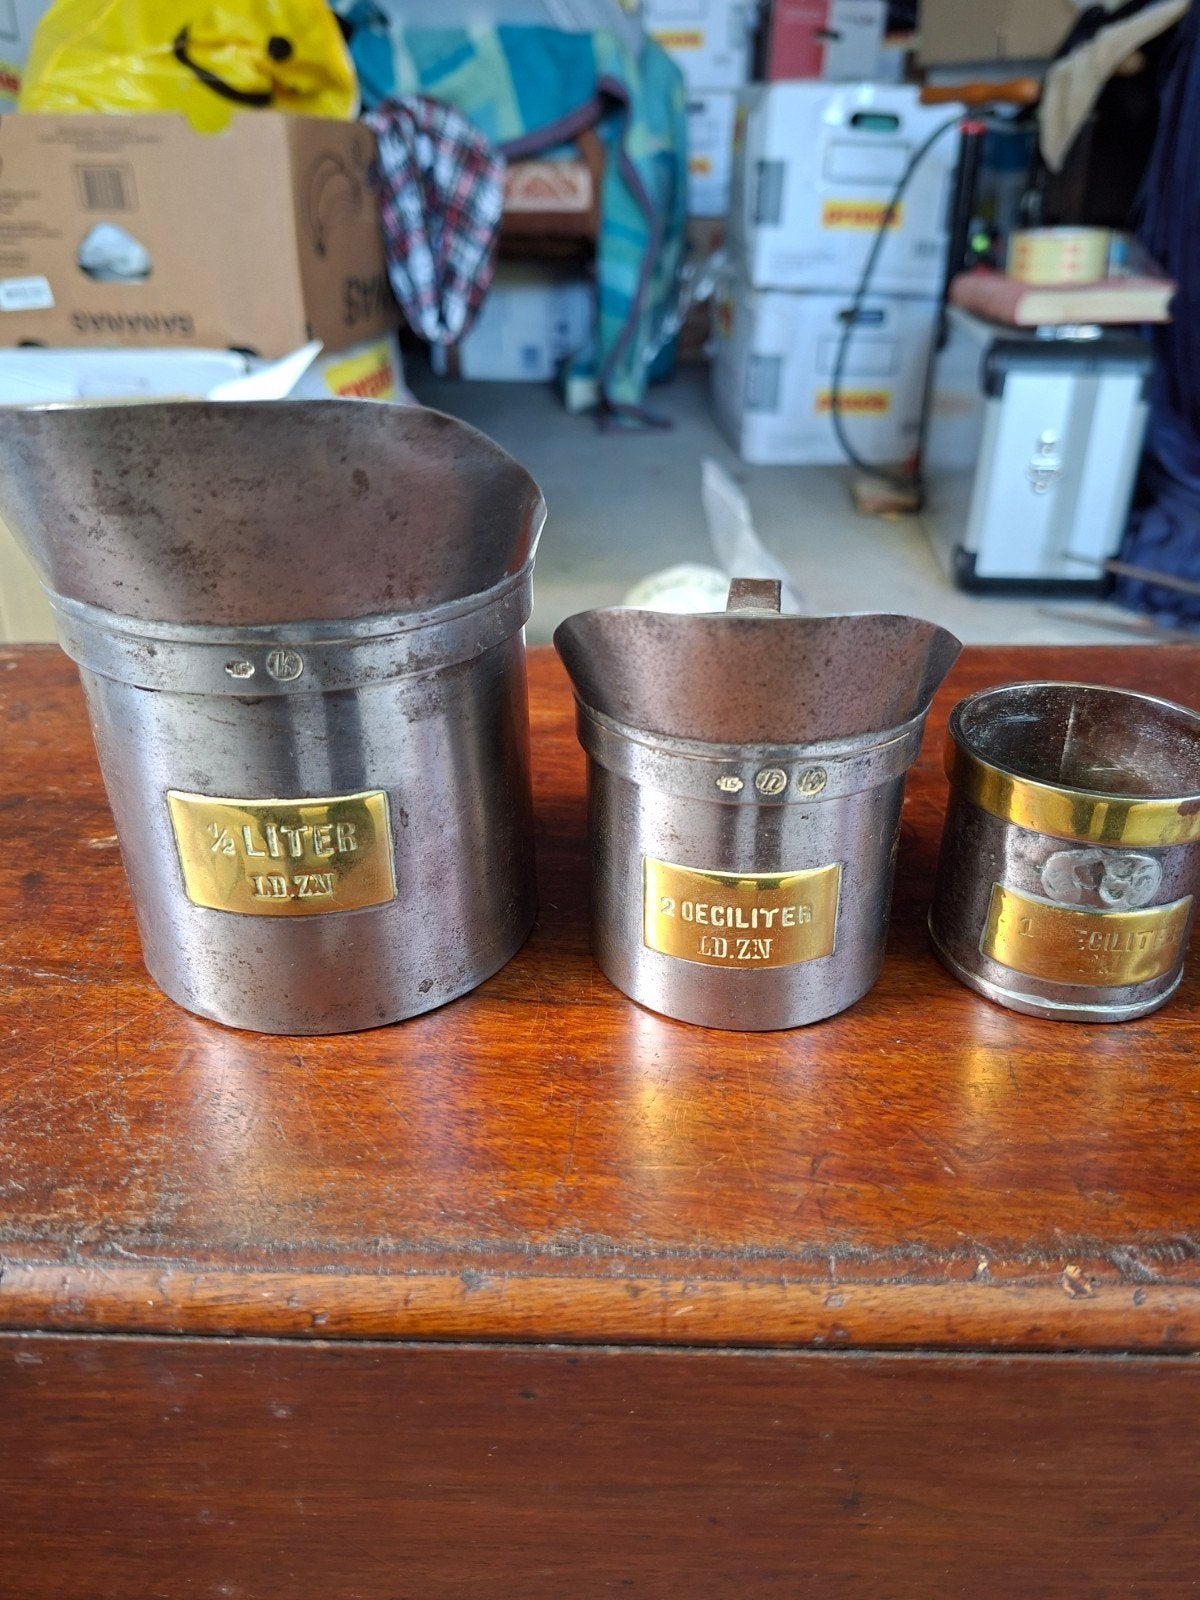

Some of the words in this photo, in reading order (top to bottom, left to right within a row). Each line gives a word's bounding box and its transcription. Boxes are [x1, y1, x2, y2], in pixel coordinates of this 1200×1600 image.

[242, 821, 359, 858] LITER
[660, 896, 675, 919] 2
[1018, 917, 1035, 939] 1
